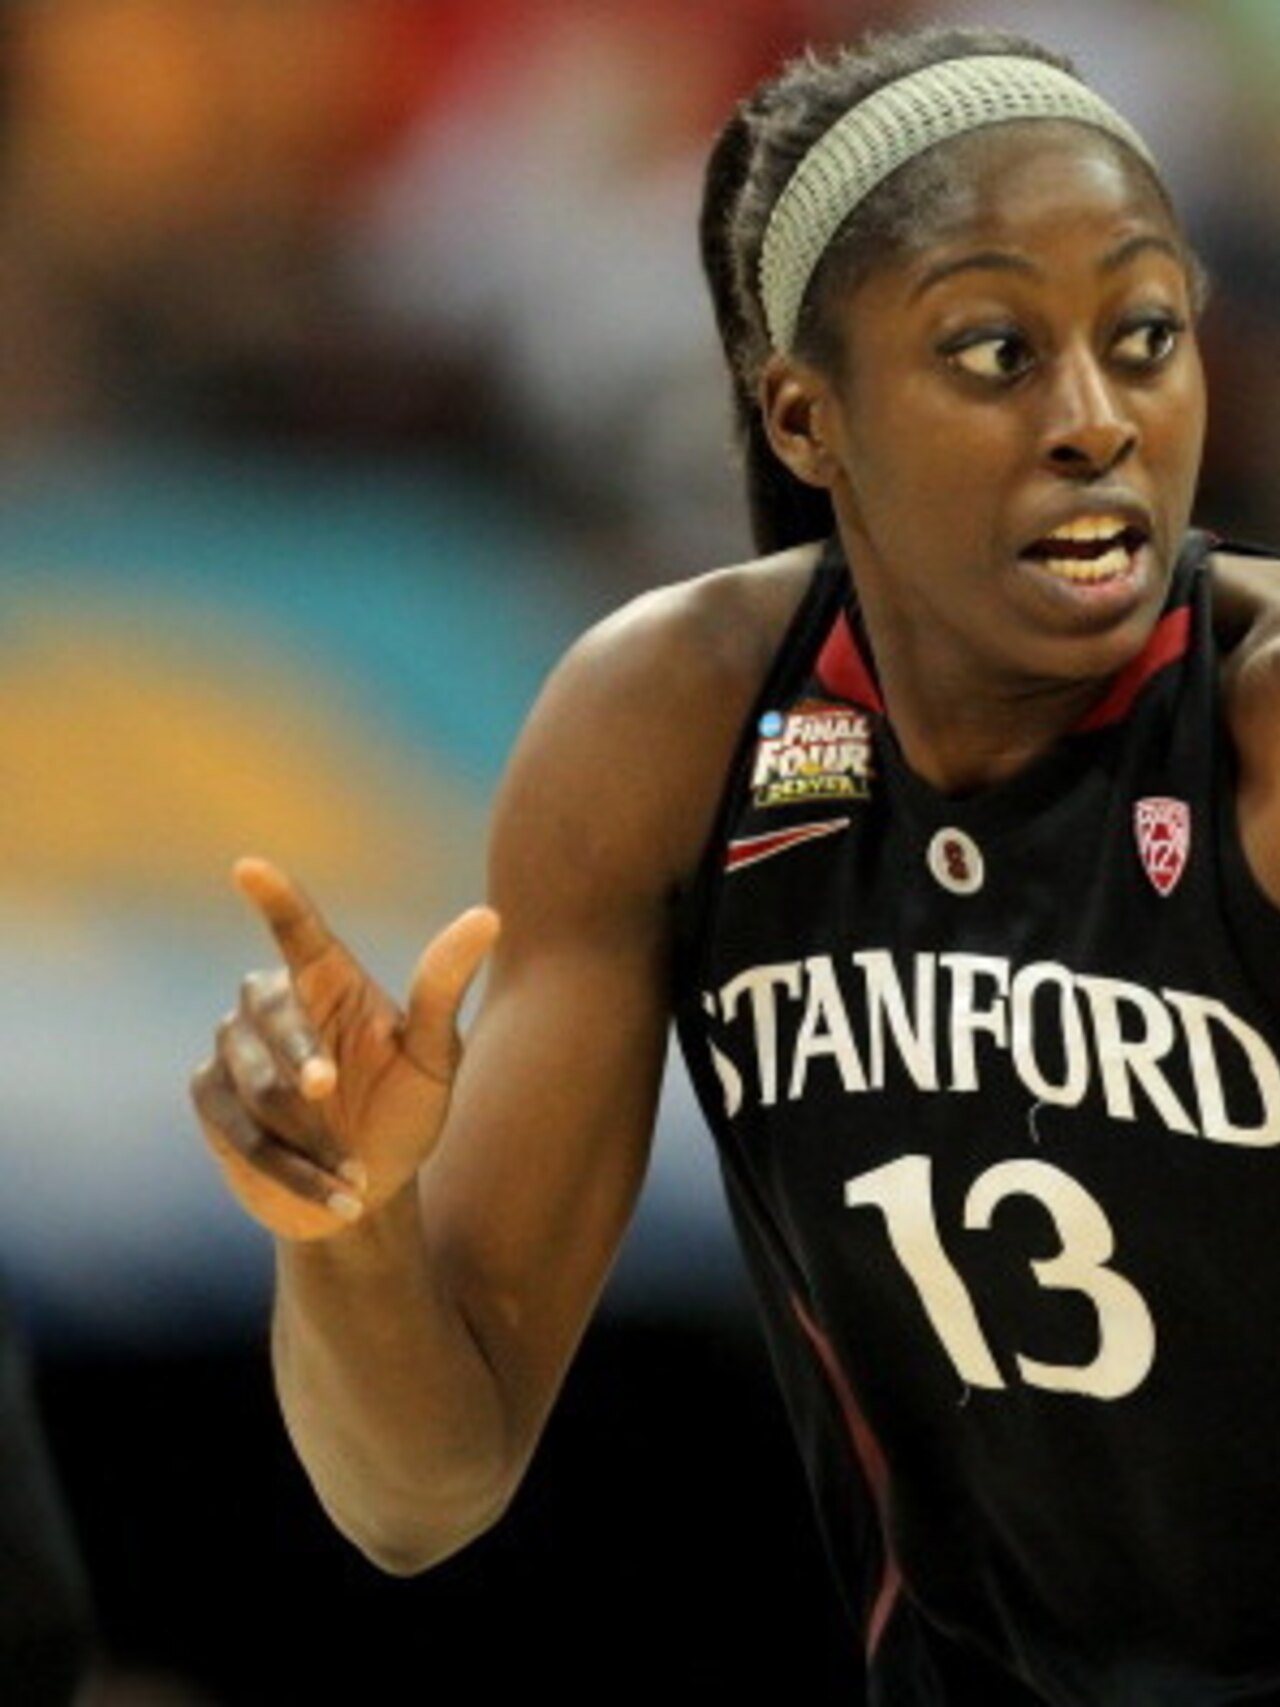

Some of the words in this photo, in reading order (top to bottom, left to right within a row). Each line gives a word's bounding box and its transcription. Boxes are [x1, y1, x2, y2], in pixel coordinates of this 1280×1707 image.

[785, 711, 870, 744] FINAL
[752, 741, 871, 786] FOUR
[844, 1154, 1156, 1400] 13
